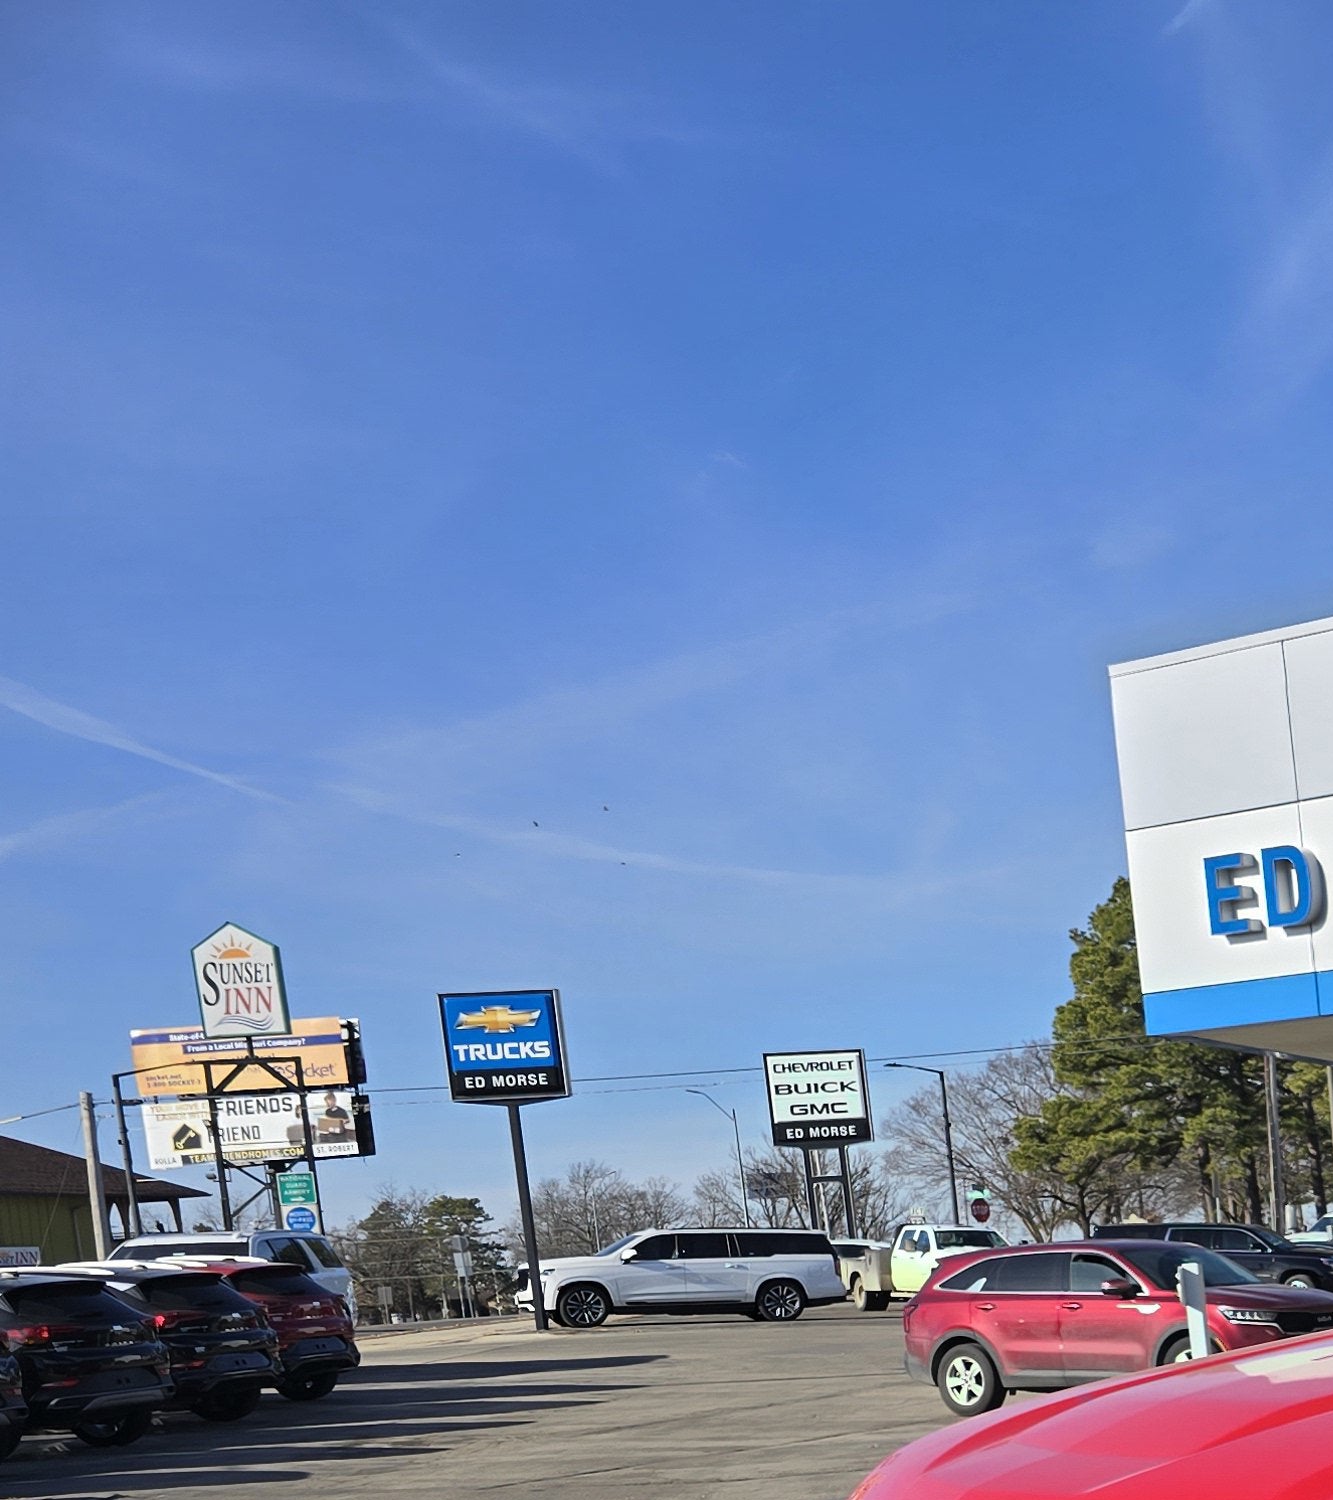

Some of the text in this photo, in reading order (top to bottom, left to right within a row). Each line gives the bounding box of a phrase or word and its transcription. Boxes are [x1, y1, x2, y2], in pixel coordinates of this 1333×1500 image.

[1203, 844, 1325, 940] ED
[202, 961, 273, 1006] SUNSET
[224, 986, 273, 1015] INN
[187, 1044, 208, 1053] From
[214, 1041, 234, 1050] Local
[267, 1038, 305, 1047] Company?
[452, 1040, 551, 1062] TRUCKS
[773, 1060, 854, 1074] CHEVROLET
[464, 1073, 549, 1089] ED MORSE
[774, 1081, 858, 1095] BUICK
[790, 1102, 848, 1116] GMC
[786, 1125, 857, 1140] ED MORSE
[328, 1144, 355, 1153] ROBERT
[155, 1157, 177, 1166] ROLLA
[15, 1251, 38, 1265] INN
